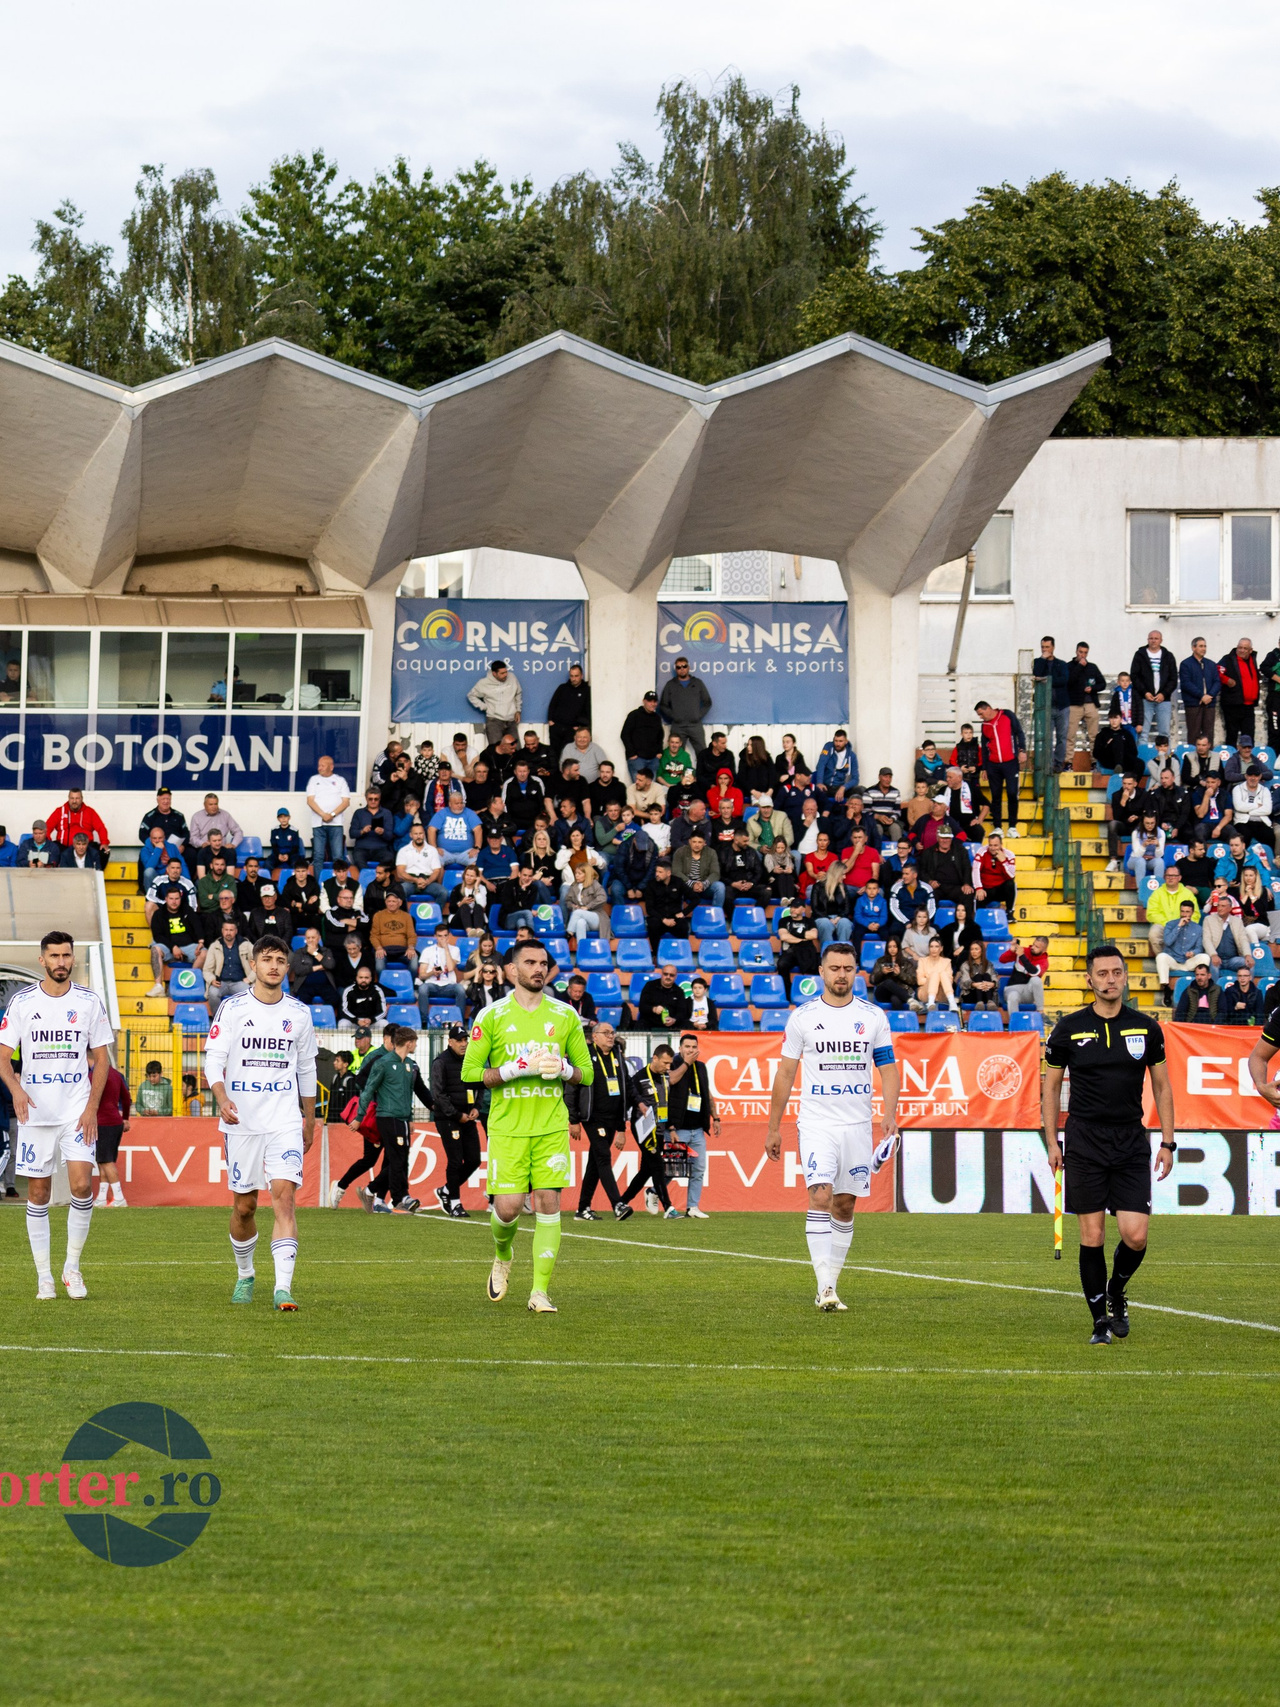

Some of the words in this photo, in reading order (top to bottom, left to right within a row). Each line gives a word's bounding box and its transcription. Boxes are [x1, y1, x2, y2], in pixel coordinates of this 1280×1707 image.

[396, 608, 580, 655] CORNIȘA
[659, 611, 843, 656] CORNIȘA
[396, 656, 492, 674] aquapark
[660, 658, 756, 675] auapark
[766, 658, 778, 672] &
[786, 658, 844, 675] sports
[44, 733, 298, 780] BOTOȘANI
[1073, 775, 1086, 786] 10
[1086, 807, 1092, 818] 9
[120, 866, 126, 878] 7
[1107, 877, 1114, 888] 7
[123, 899, 131, 910] 6
[1020, 908, 1026, 919] 6
[1117, 909, 1124, 920] 6
[126, 933, 134, 945] 5
[1129, 943, 1136, 955] 5
[131, 966, 138, 978] 4
[1044, 976, 1050, 987] 4
[1140, 977, 1147, 988] 4
[136, 1002, 144, 1013] 3
[31, 1030, 81, 1042] UNIBET
[140, 1036, 147, 1048] 2
[242, 1038, 293, 1051] UNIBET
[815, 1041, 869, 1053] UNIBET
[26, 1073, 82, 1084] ELSACO
[232, 1080, 292, 1092] ELSACO
[811, 1084, 870, 1095] ELSACO
[503, 1087, 562, 1098] ELSACO
[936, 1102, 970, 1116] BUN
[22, 1142, 36, 1163] 16
[118, 1146, 196, 1182] TV
[808, 1152, 817, 1170] 4
[233, 1162, 241, 1180] 6
[492, 1159, 497, 1180] 1
